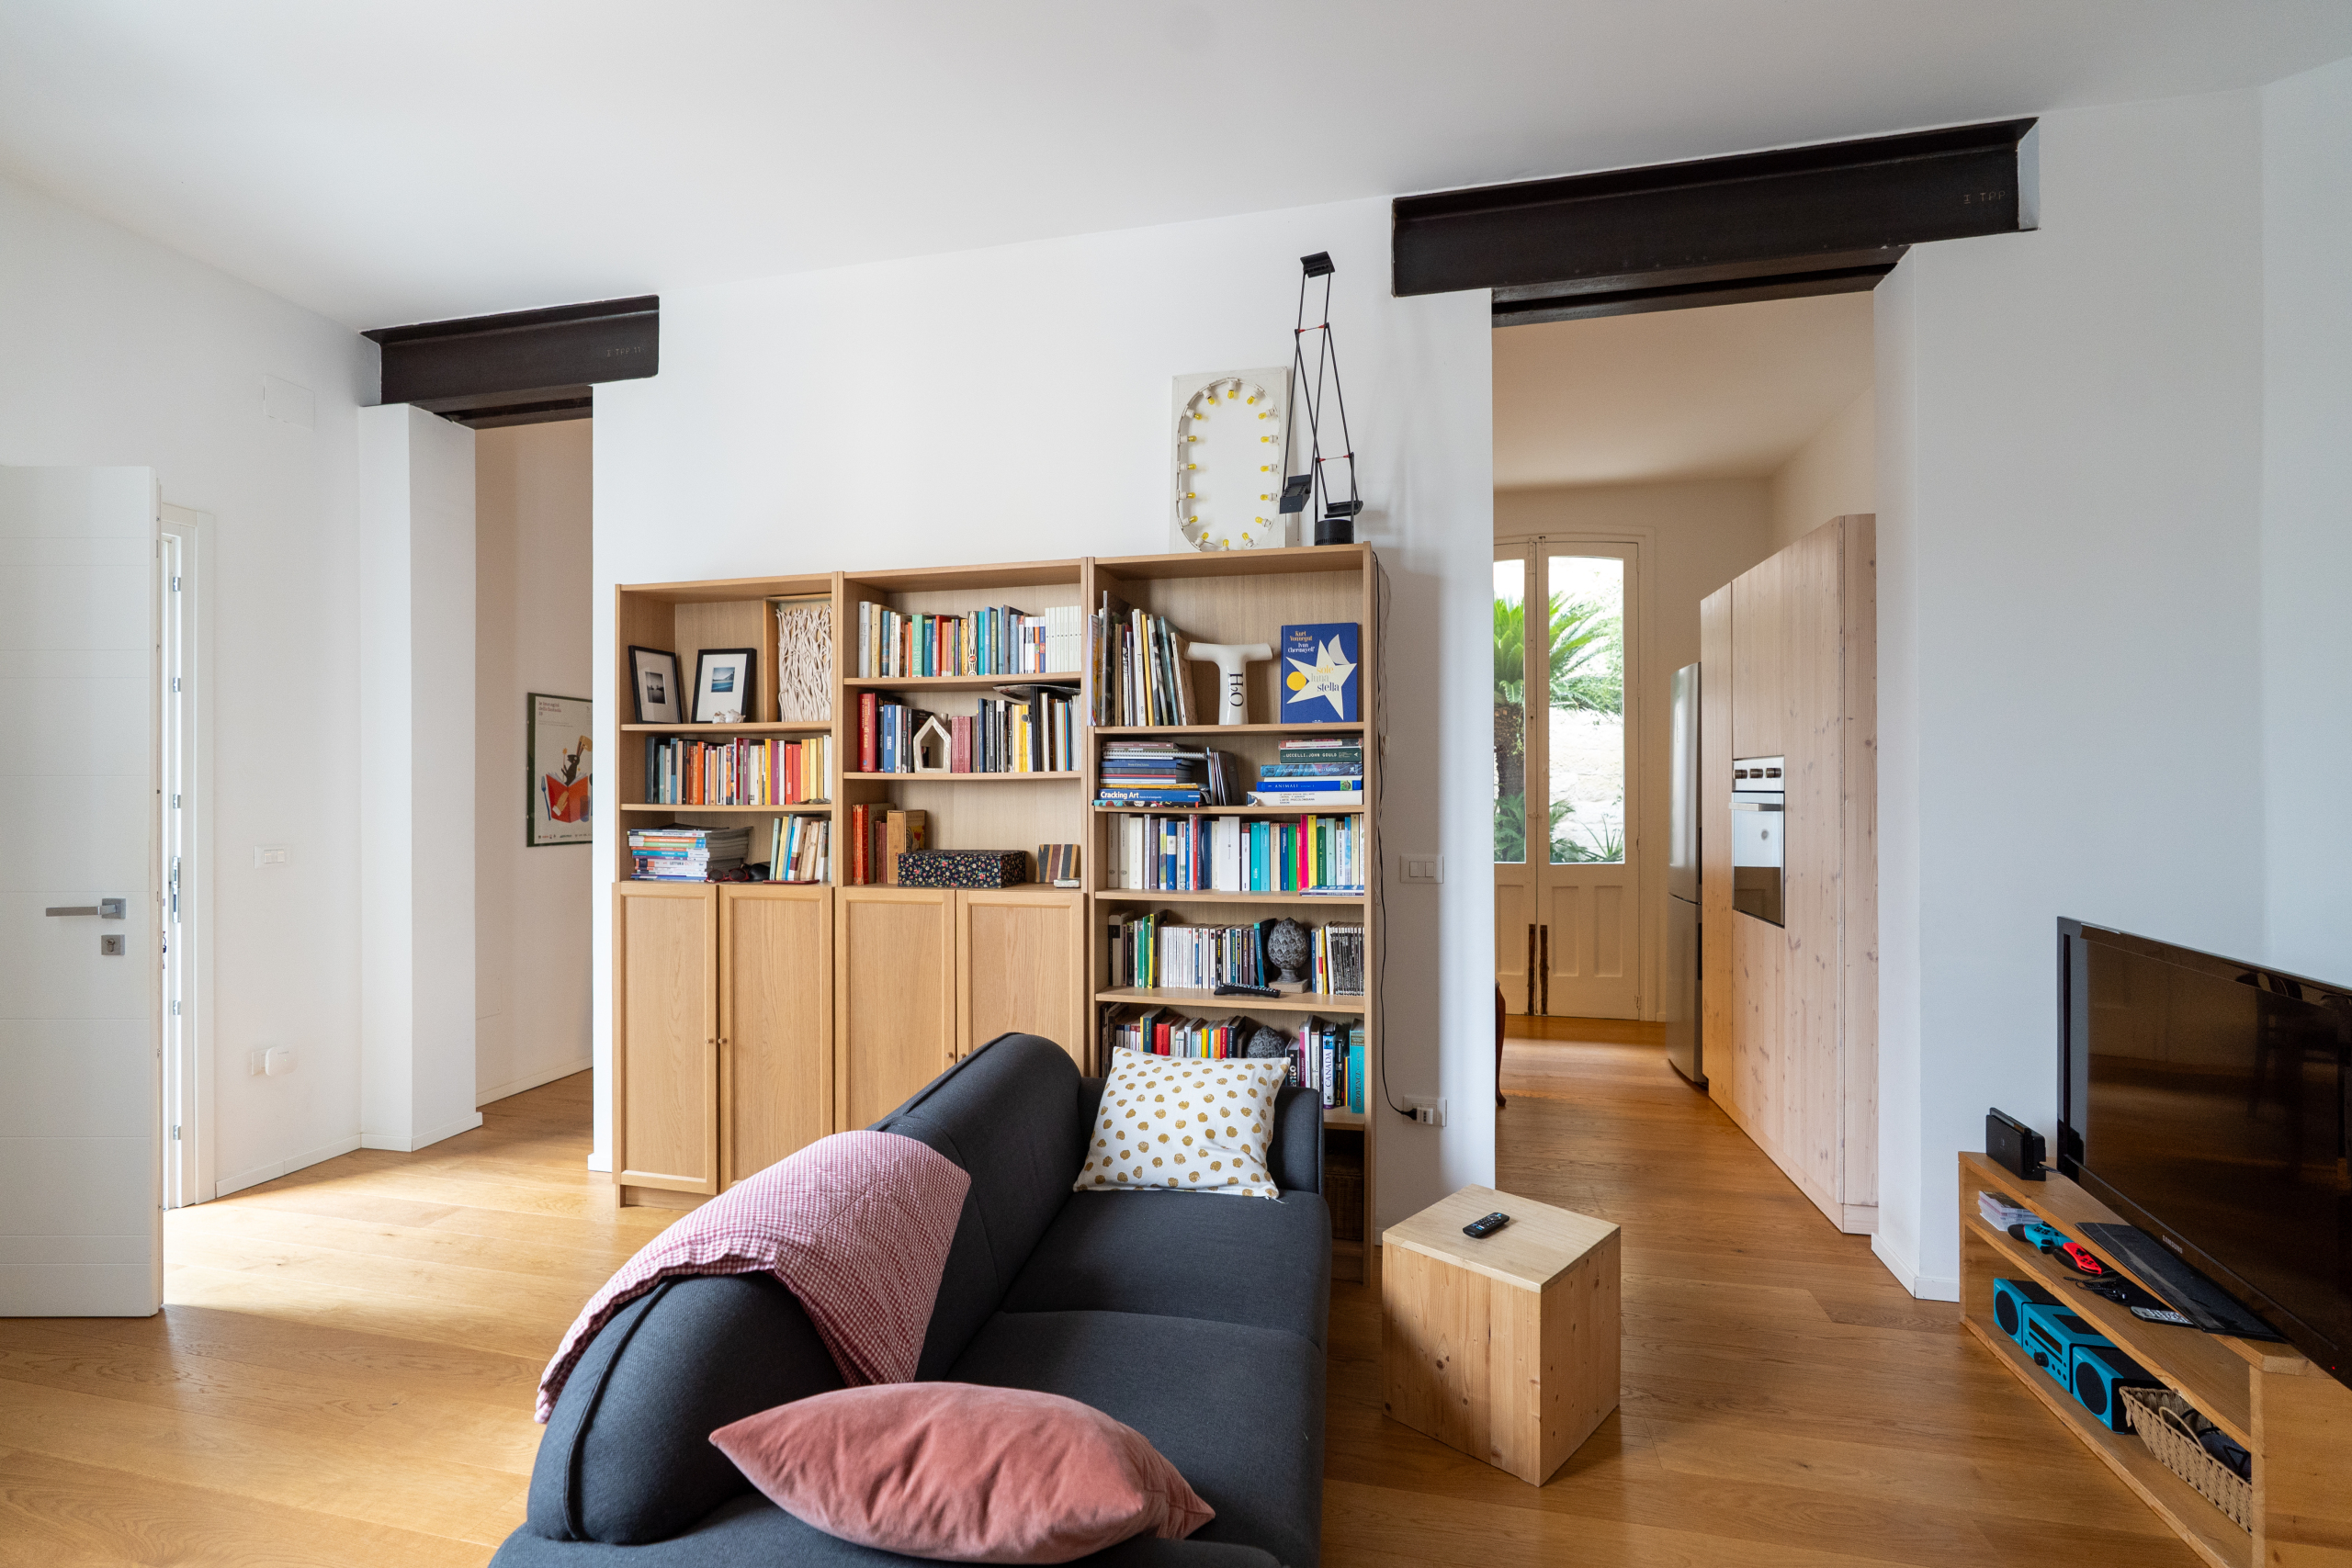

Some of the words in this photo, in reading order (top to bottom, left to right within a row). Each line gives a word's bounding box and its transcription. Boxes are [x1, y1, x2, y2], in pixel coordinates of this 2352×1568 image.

[1317, 665, 1334, 674] sole
[1311, 673, 1329, 682] luna
[1317, 682, 1339, 692] stella
[1100, 791, 1128, 799] Cracking
